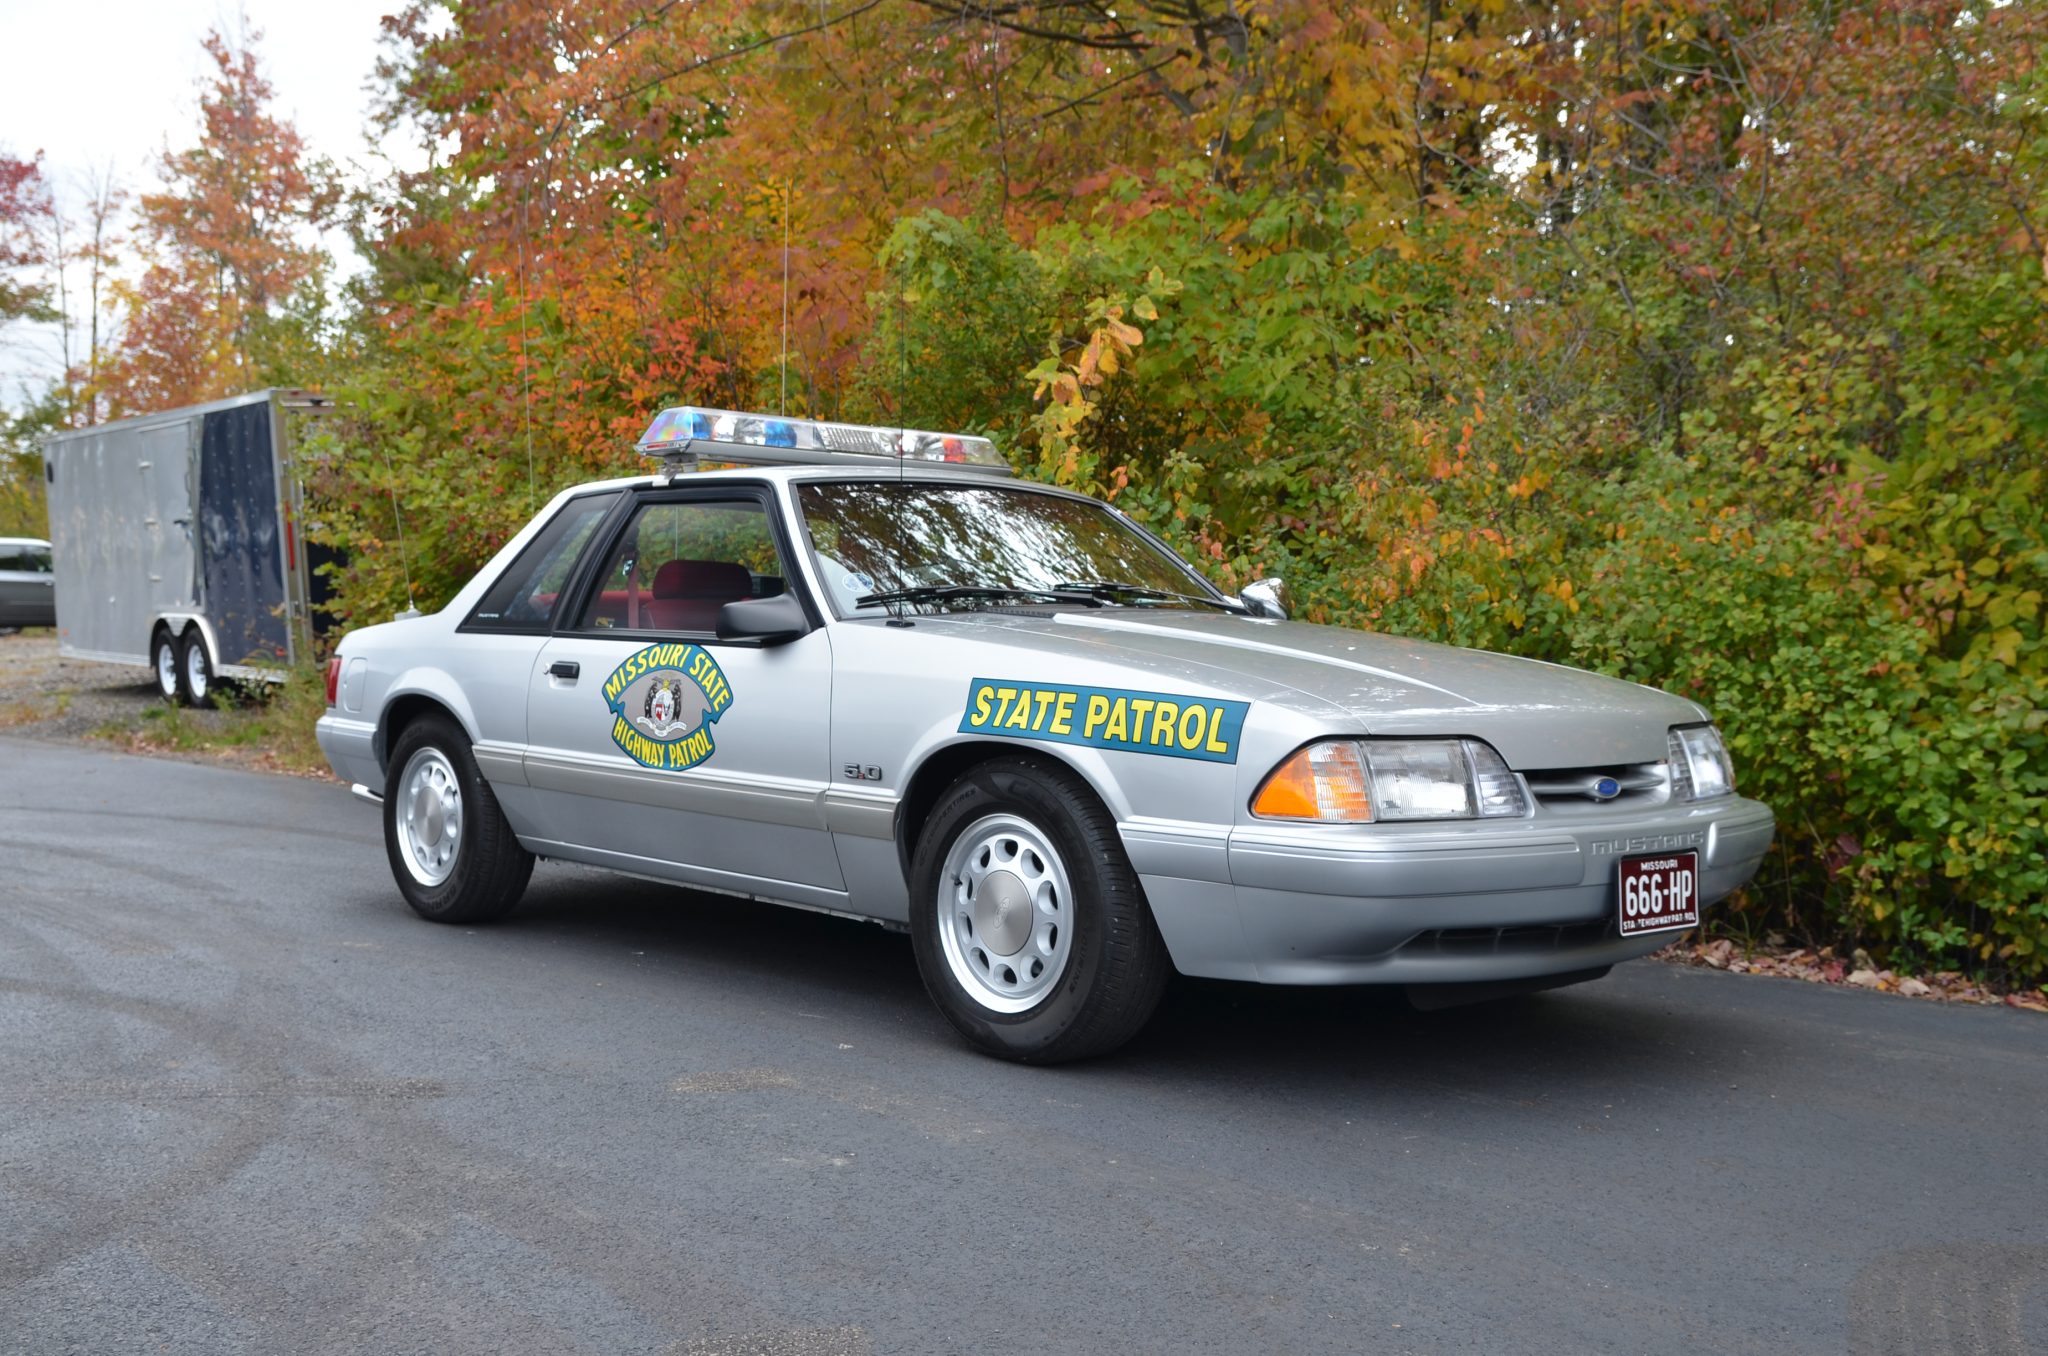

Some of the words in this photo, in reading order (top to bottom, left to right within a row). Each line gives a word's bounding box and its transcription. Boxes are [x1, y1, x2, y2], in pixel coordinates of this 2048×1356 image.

[604, 643, 692, 701] MISSOURI
[689, 652, 730, 712] STATE
[613, 717, 665, 768] HIGHWAY
[668, 728, 713, 768] PATROL
[970, 685, 1078, 736] STATE
[1083, 695, 1229, 754] PATROL
[843, 762, 882, 781] 5.0
[1592, 832, 1704, 855] MUSTANG
[1640, 859, 1678, 871] MISSOURI
[1625, 870, 1692, 917] 666-HP
